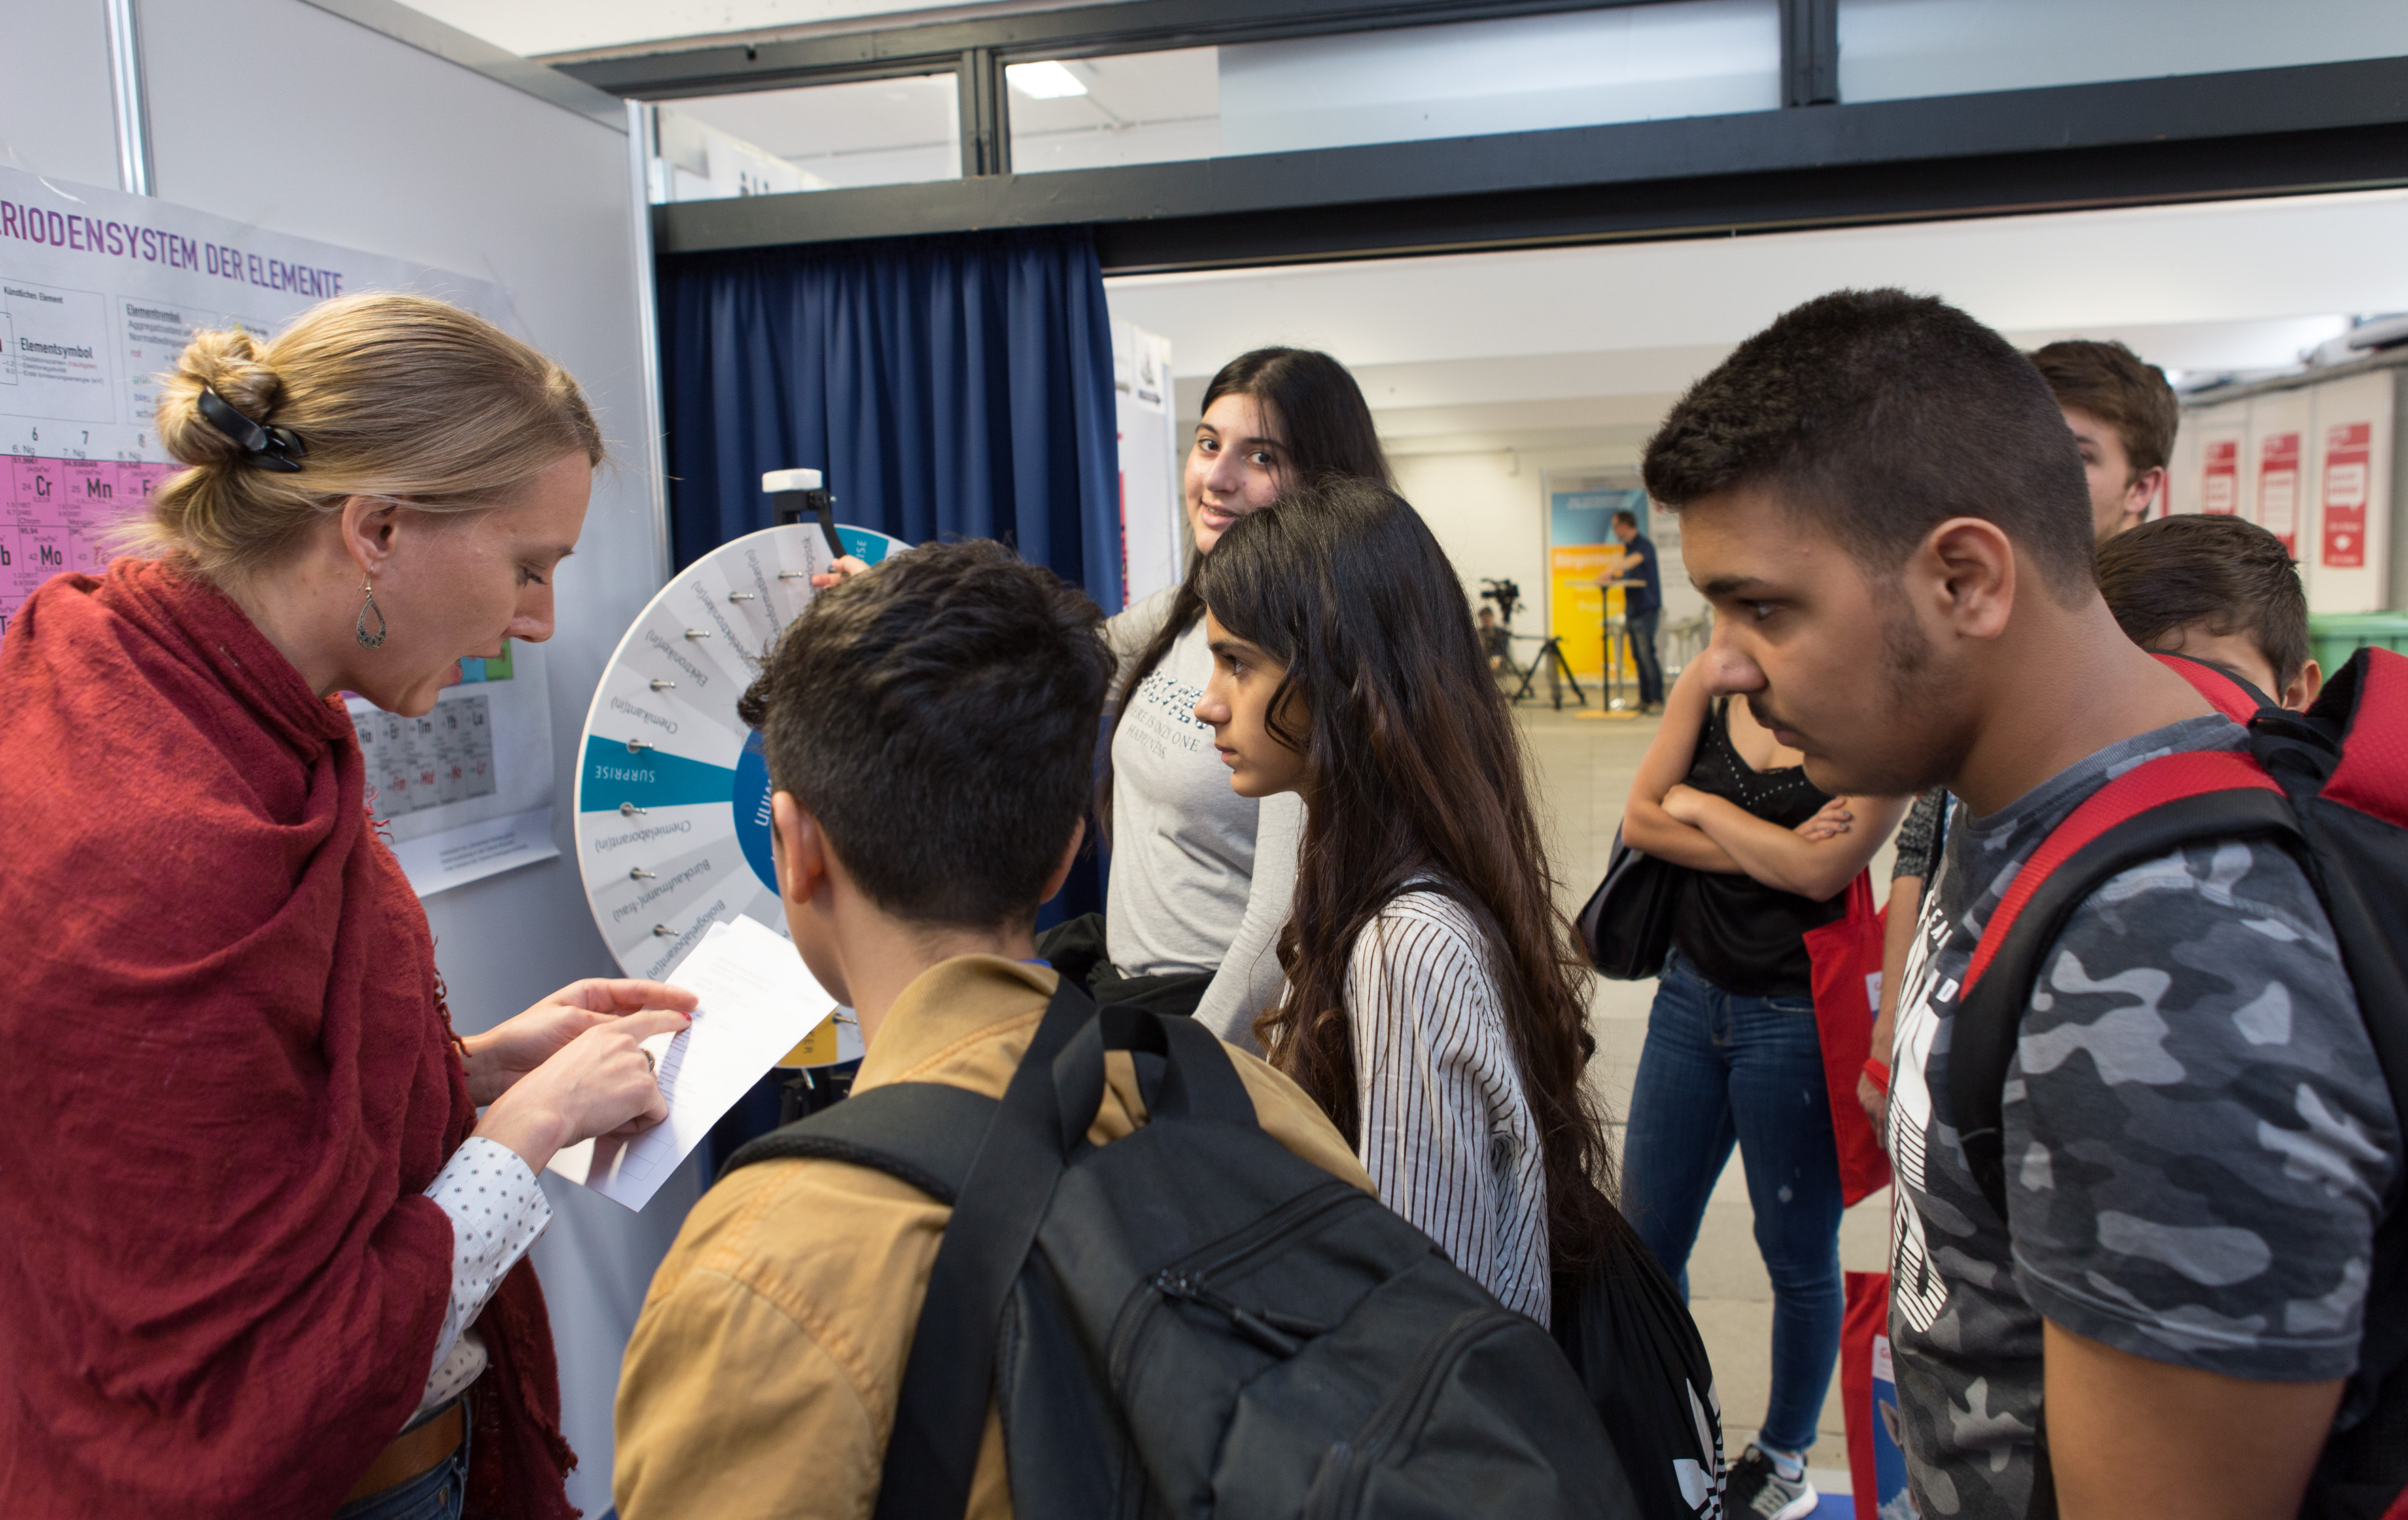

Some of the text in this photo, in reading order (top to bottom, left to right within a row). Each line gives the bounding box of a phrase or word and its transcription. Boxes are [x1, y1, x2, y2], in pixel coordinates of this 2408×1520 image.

[0, 200, 343, 299] RIODENSYSTEM DER ELEMENTE
[39, 292, 64, 304] Element
[20, 337, 94, 359] Elementsymbol
[32, 427, 39, 441] 6
[81, 430, 88, 444] 7
[138, 434, 145, 448] 8
[36, 475, 52, 497] Cr
[86, 478, 112, 499] Mn
[0, 544, 11, 566] b
[39, 544, 62, 566] Mo
[744, 548, 782, 637] chinformatiker(in)
[644, 628, 709, 688] Elektroniker(in)
[610, 695, 678, 735] Chemikant(in)
[1130, 703, 1149, 724] HERE
[1146, 713, 1156, 728] IS
[1172, 731, 1201, 752] ONE
[1126, 724, 1168, 760] HAPPINESS
[595, 765, 655, 783] SURPRISE
[594, 819, 692, 854] Chemielaborant(in)
[612, 858, 712, 923] Bürokaufmann(-frau)
[646, 899, 727, 980] Biologielaborant(in)
